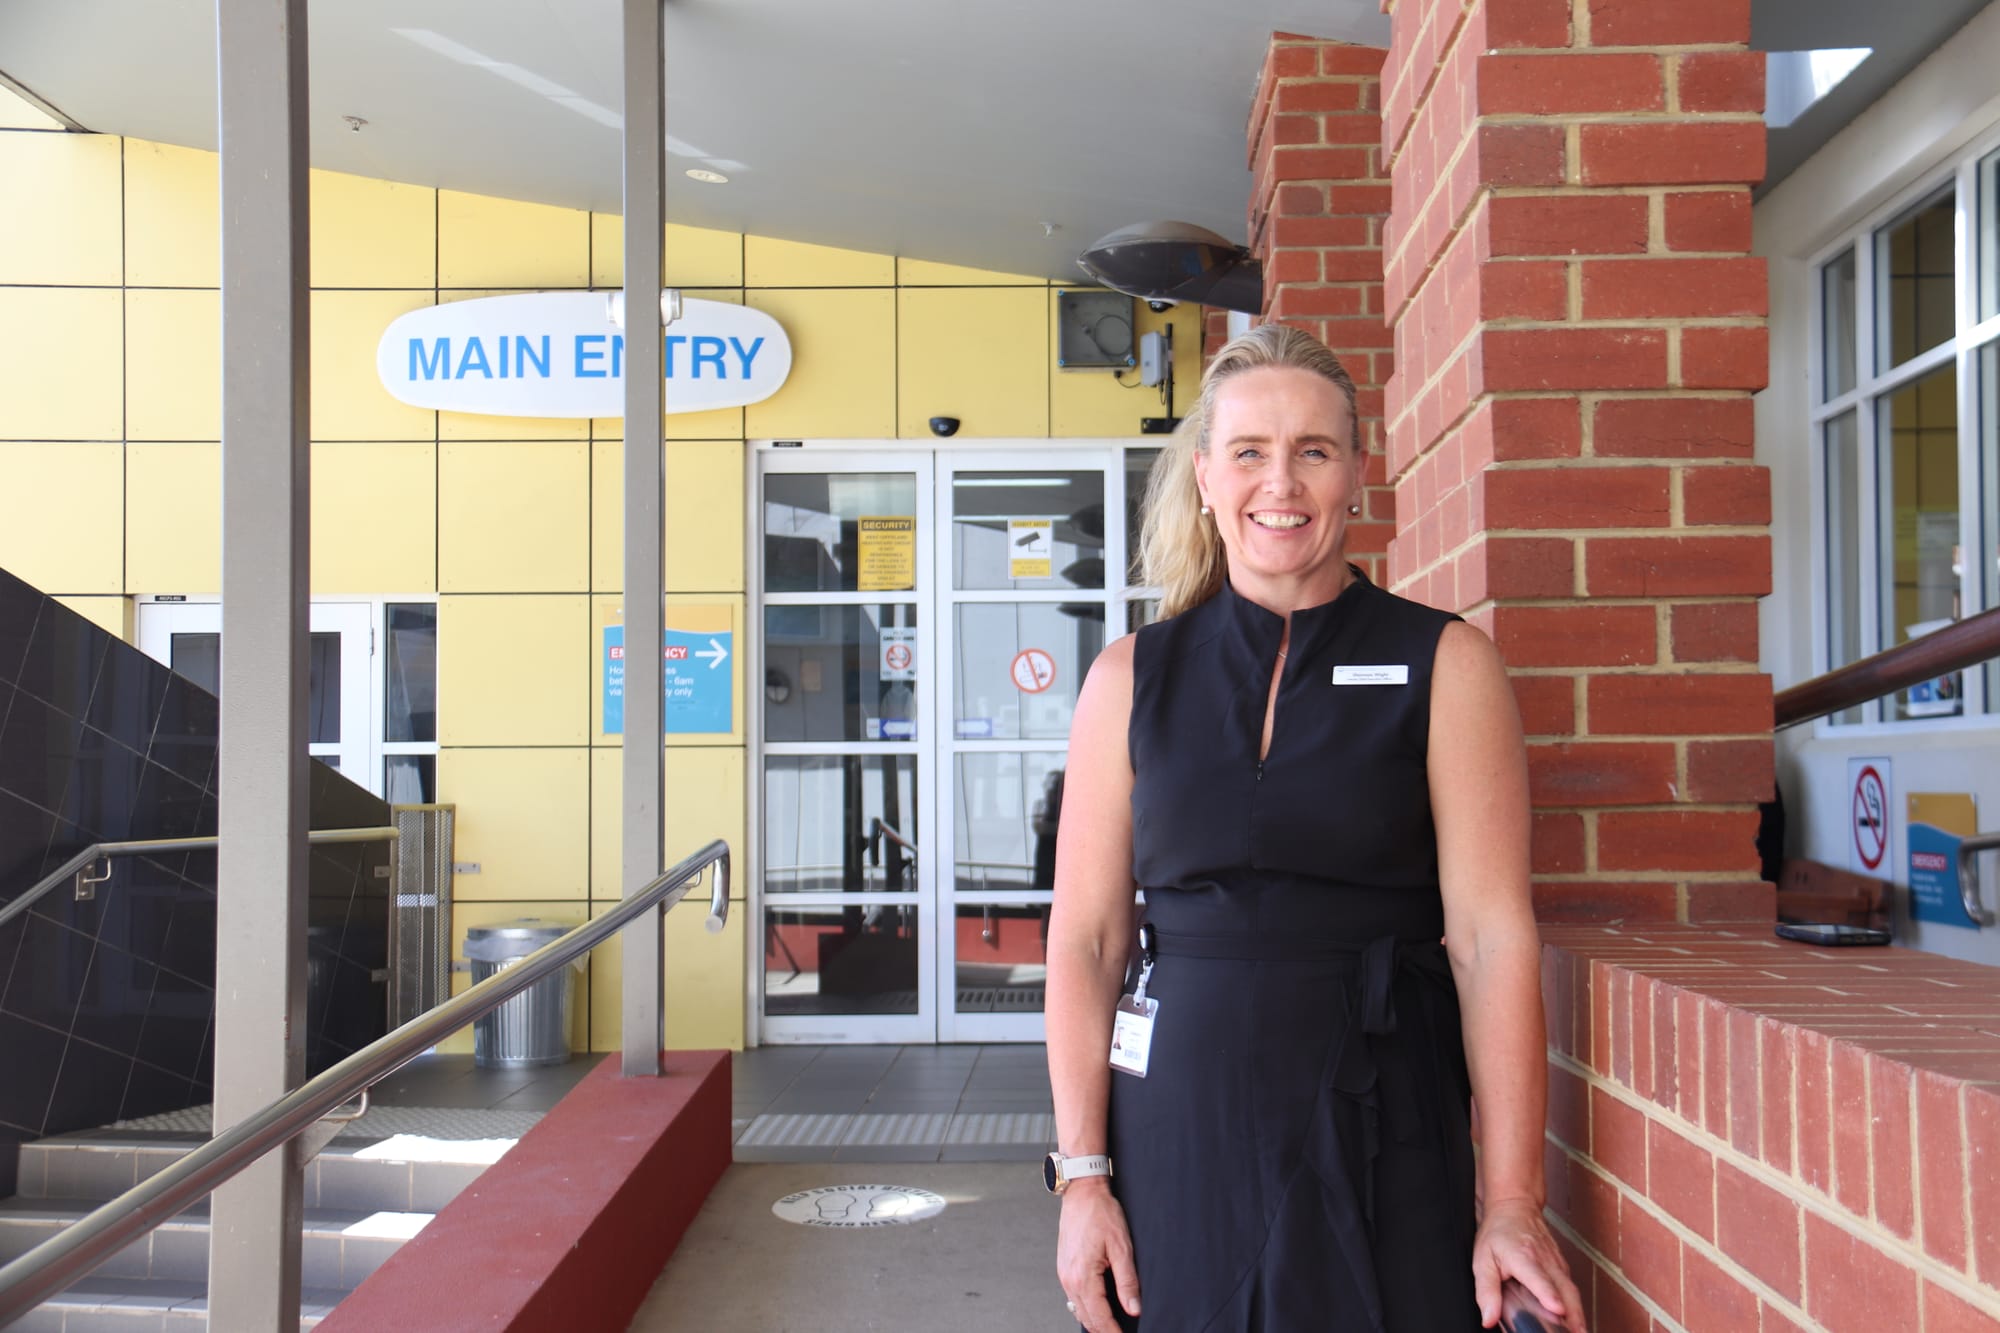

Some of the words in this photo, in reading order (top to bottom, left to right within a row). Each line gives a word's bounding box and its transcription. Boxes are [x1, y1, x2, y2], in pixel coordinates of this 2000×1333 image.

[408, 335, 551, 381] MAIN
[863, 520, 910, 529] SECURITY
[674, 676, 694, 686] 6am
[609, 687, 622, 696] via
[674, 686, 693, 698] only
